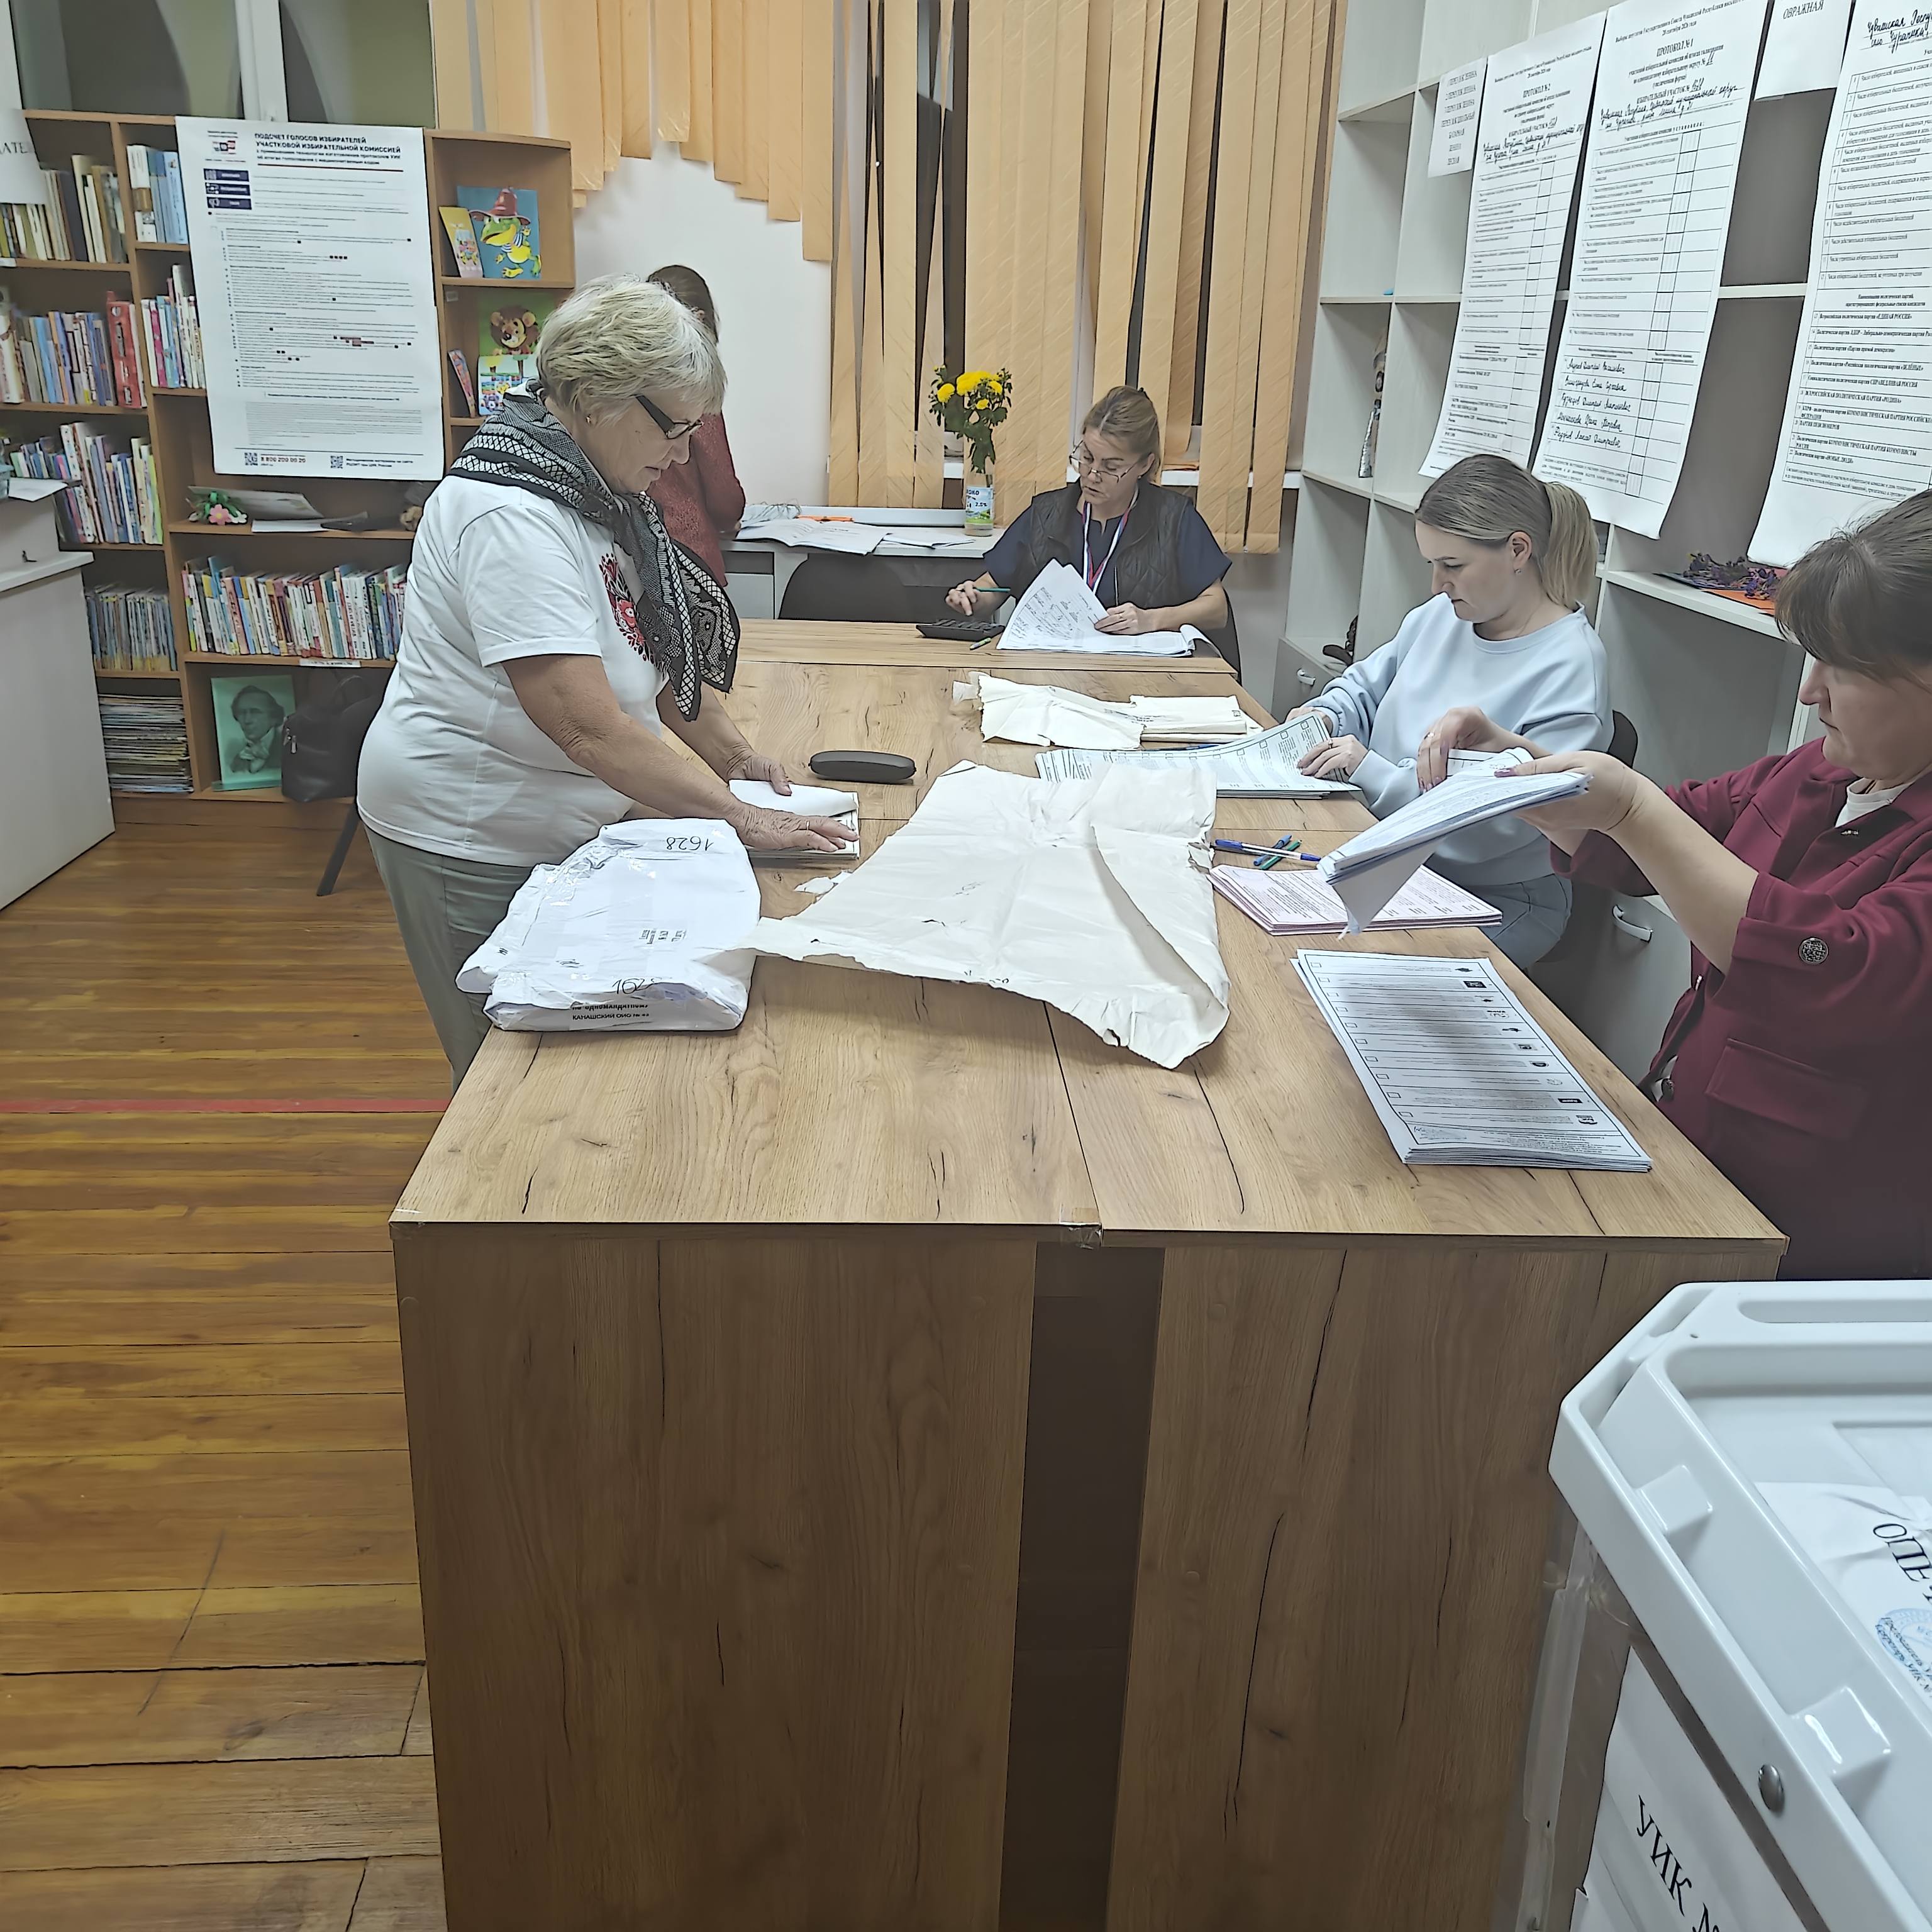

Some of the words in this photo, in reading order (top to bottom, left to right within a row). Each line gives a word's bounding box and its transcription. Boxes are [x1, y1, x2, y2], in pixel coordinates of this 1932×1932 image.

[1784, 0, 1824, 19] ОВРАЖНАЯ
[666, 836, 714, 851] 1628
[612, 978, 655, 994] 162
[1636, 1794, 1692, 1918] УИК
